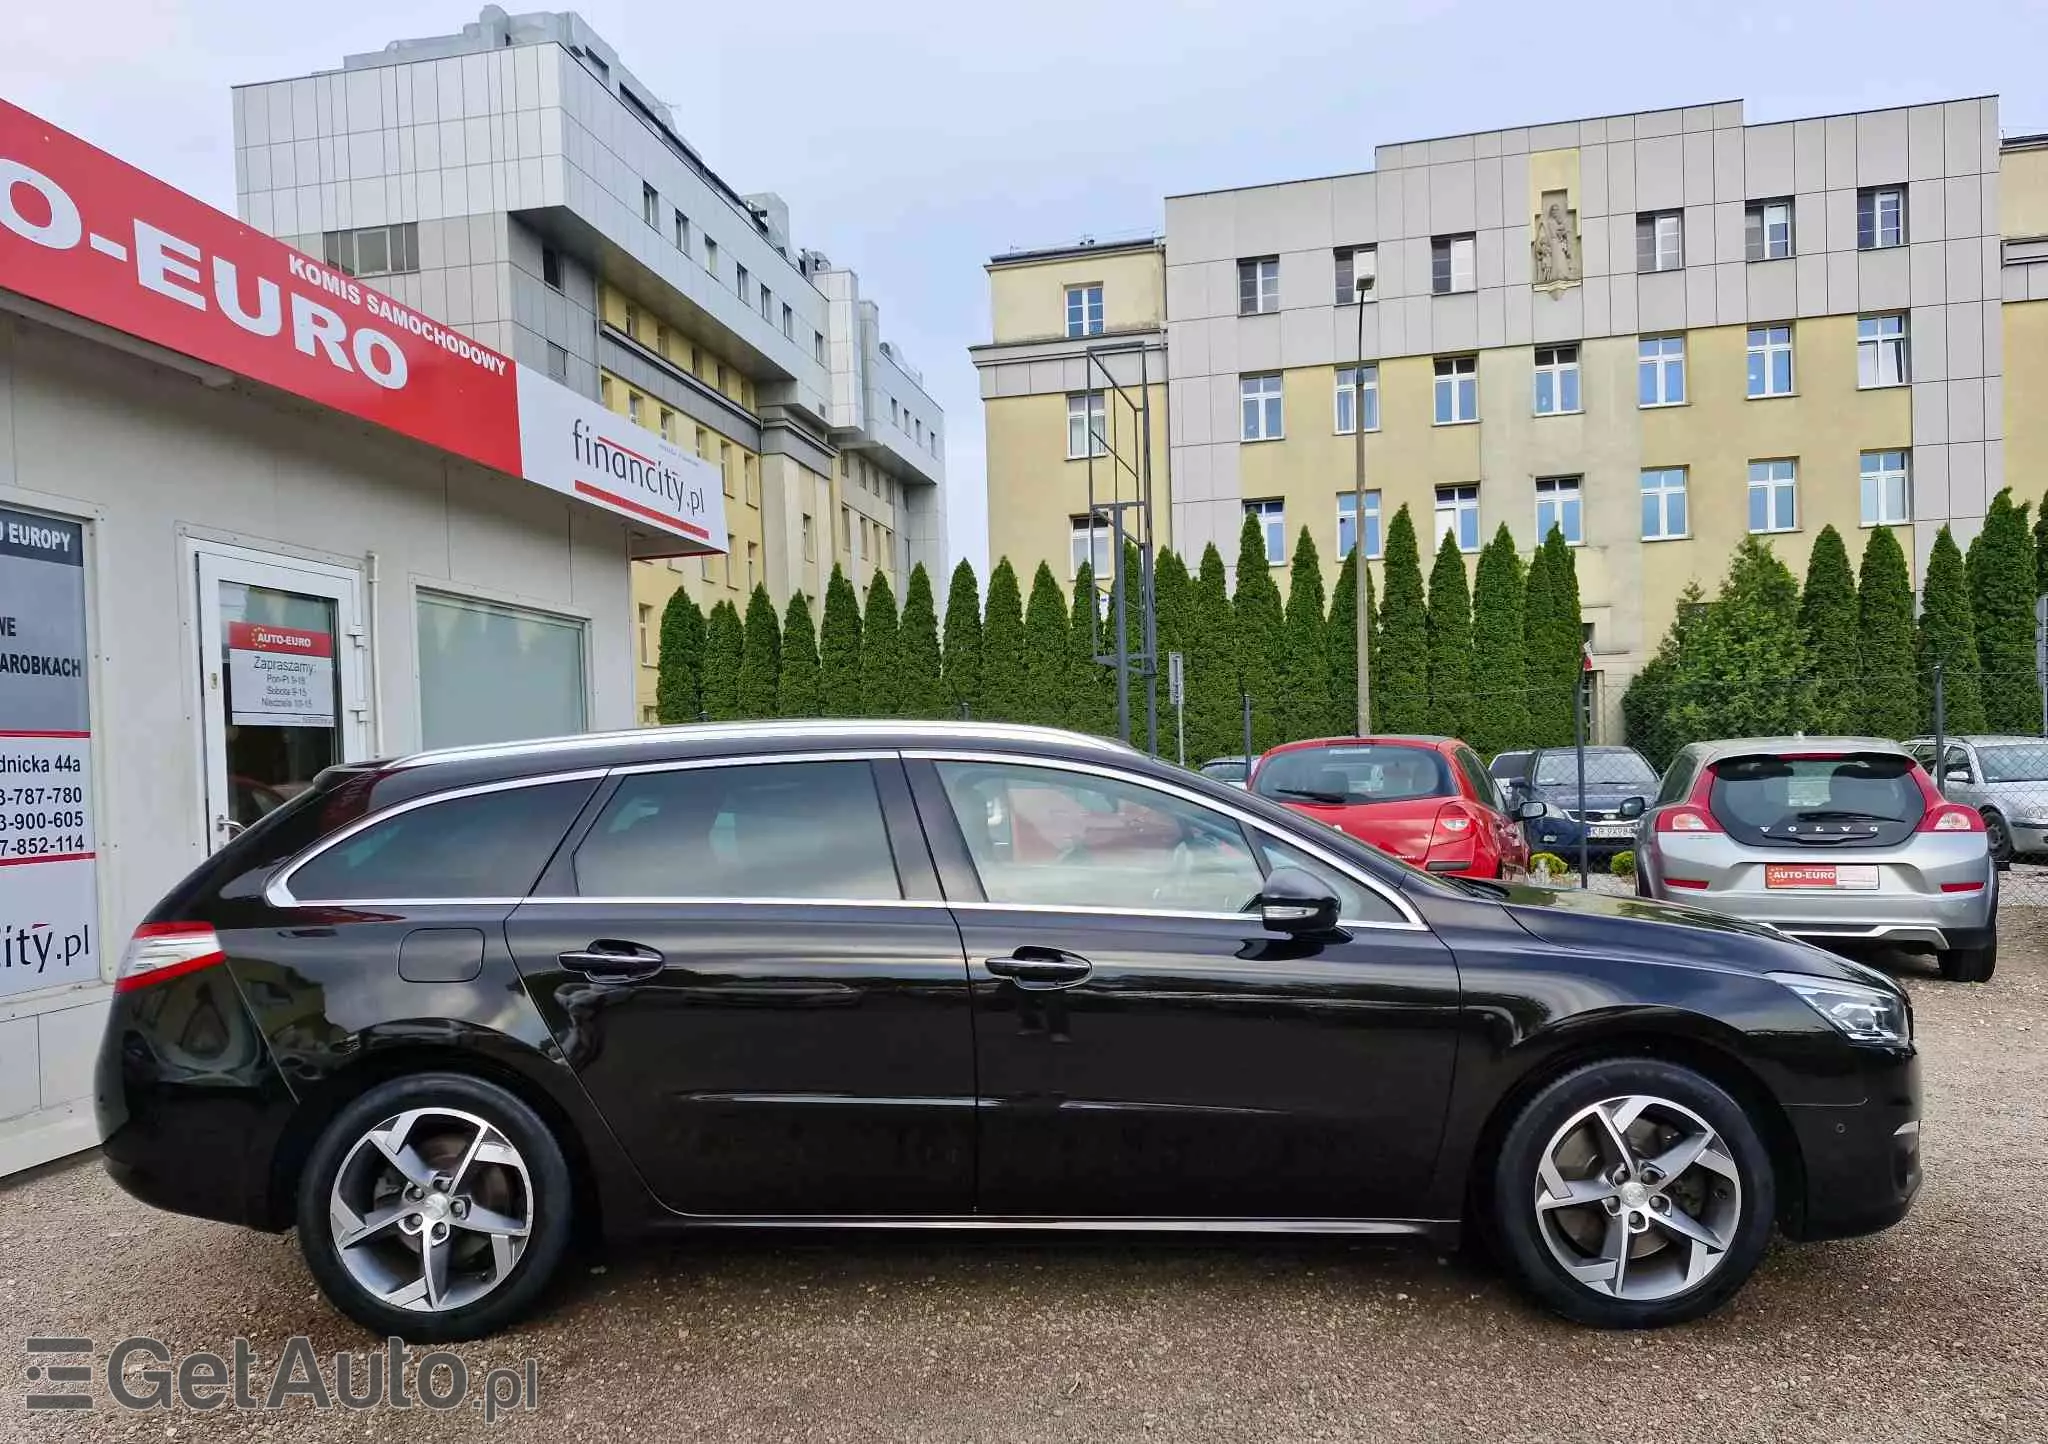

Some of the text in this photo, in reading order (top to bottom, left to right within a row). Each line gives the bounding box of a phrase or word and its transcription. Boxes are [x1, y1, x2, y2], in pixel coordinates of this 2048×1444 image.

[289, 253, 506, 377] KOMIS SAMOCHODOWY
[572, 418, 706, 517] financity.pl
[8, 521, 71, 553] EUROPY
[257, 632, 312, 648] AUTO-EURO
[253, 655, 317, 676] Zapraszamy:
[54, 754, 81, 773] 44a
[0, 834, 85, 857] 7-852-114
[1774, 870, 1835, 880] AUTO-EURO
[0, 924, 89, 974] ity.pl
